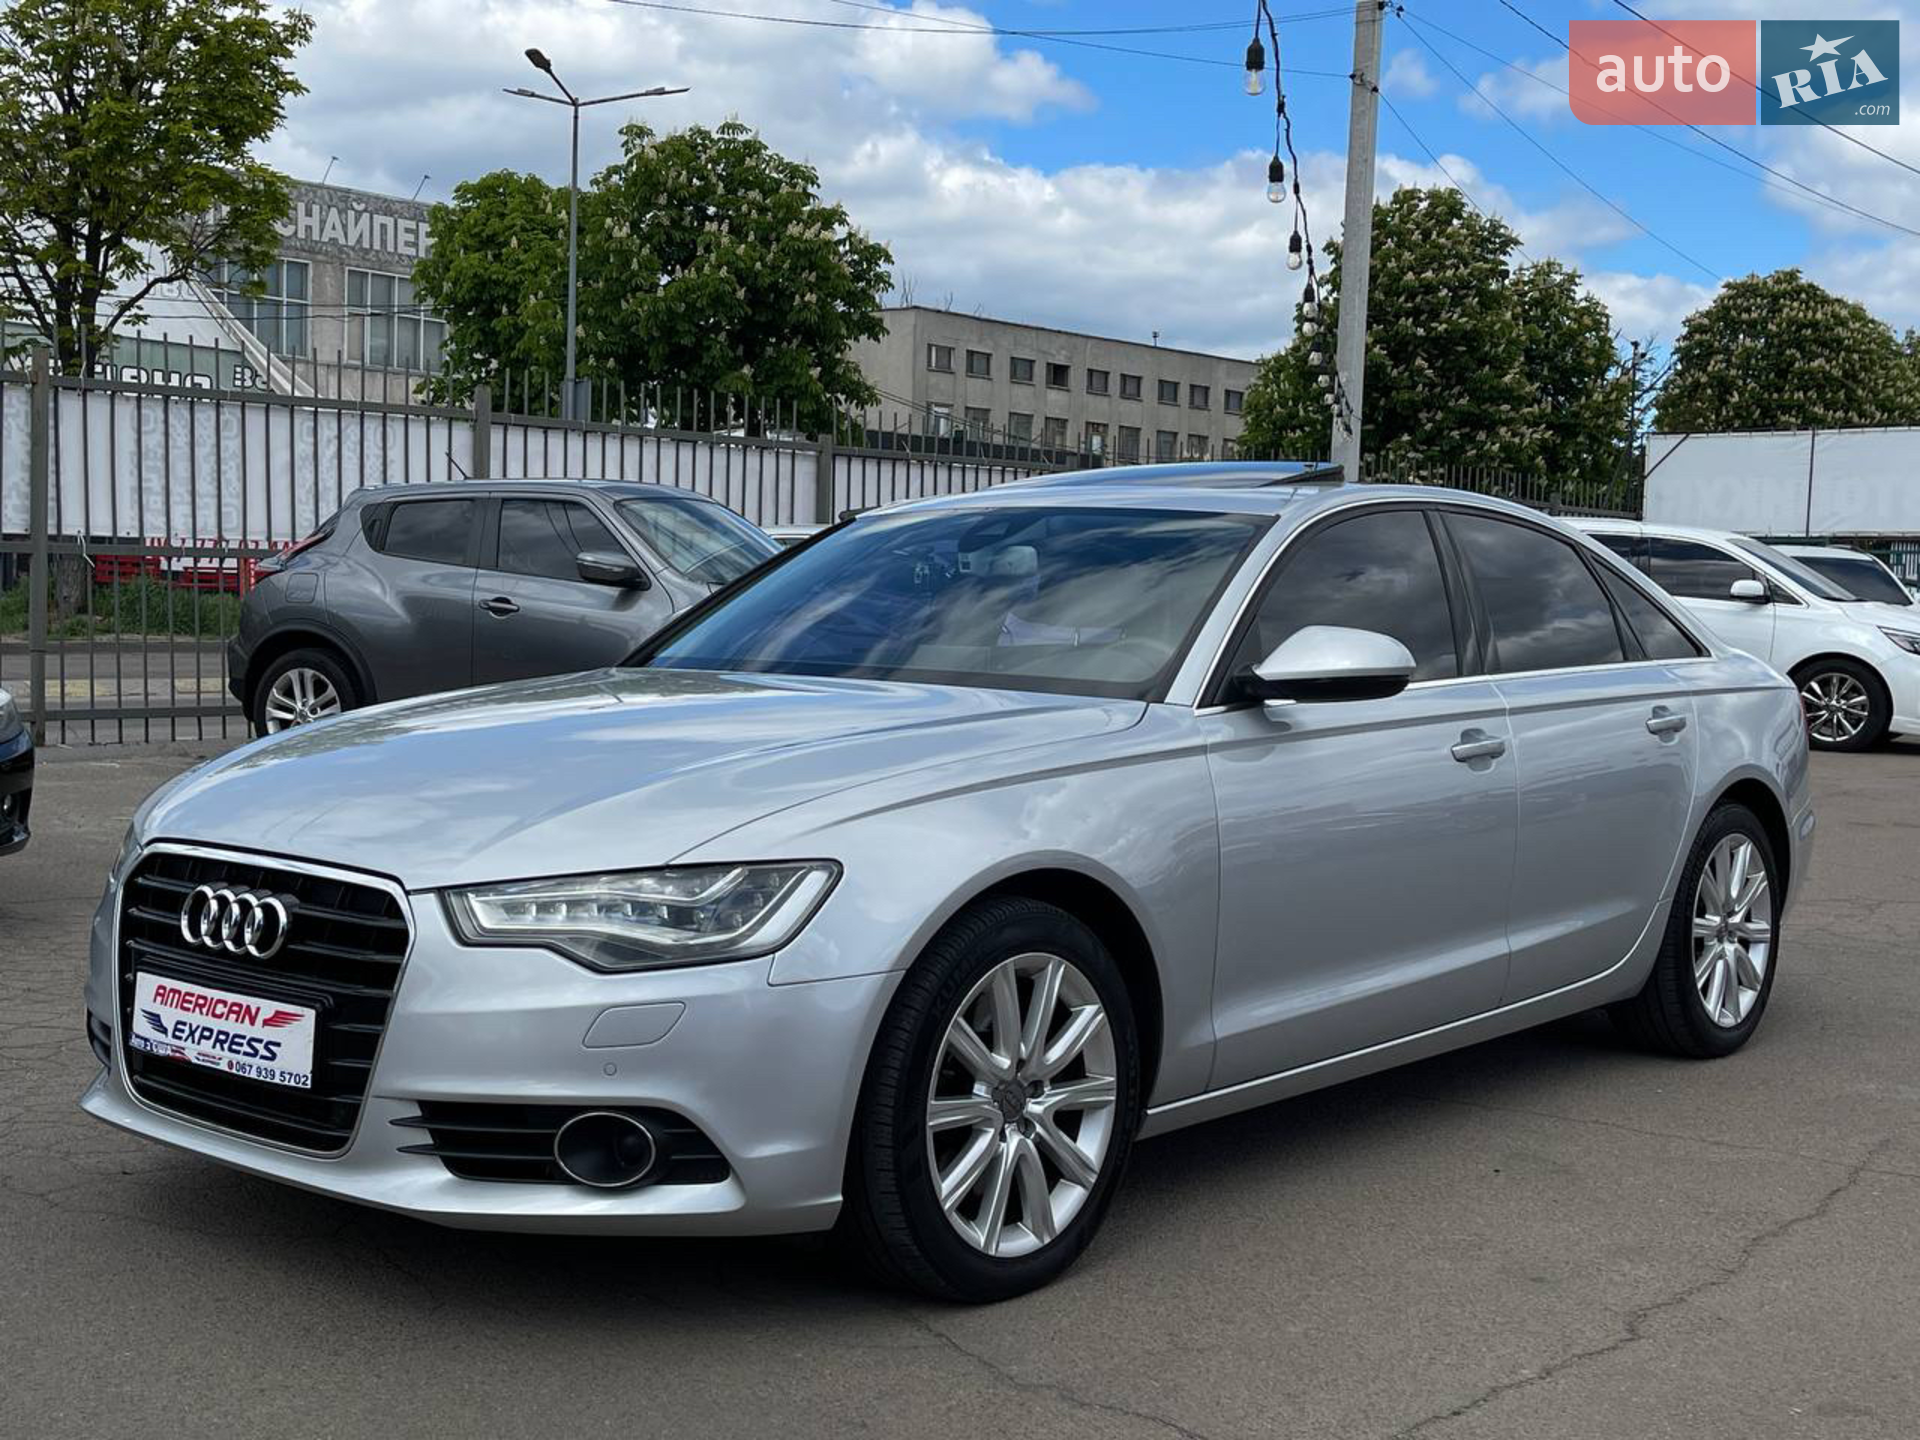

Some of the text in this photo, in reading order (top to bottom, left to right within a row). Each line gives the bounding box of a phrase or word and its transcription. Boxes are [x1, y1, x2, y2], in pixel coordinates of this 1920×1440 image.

[153, 984, 261, 1026] AMERICAN
[172, 1020, 282, 1062] EXPRESS
[235, 1061, 309, 1087] 067 939 5702
